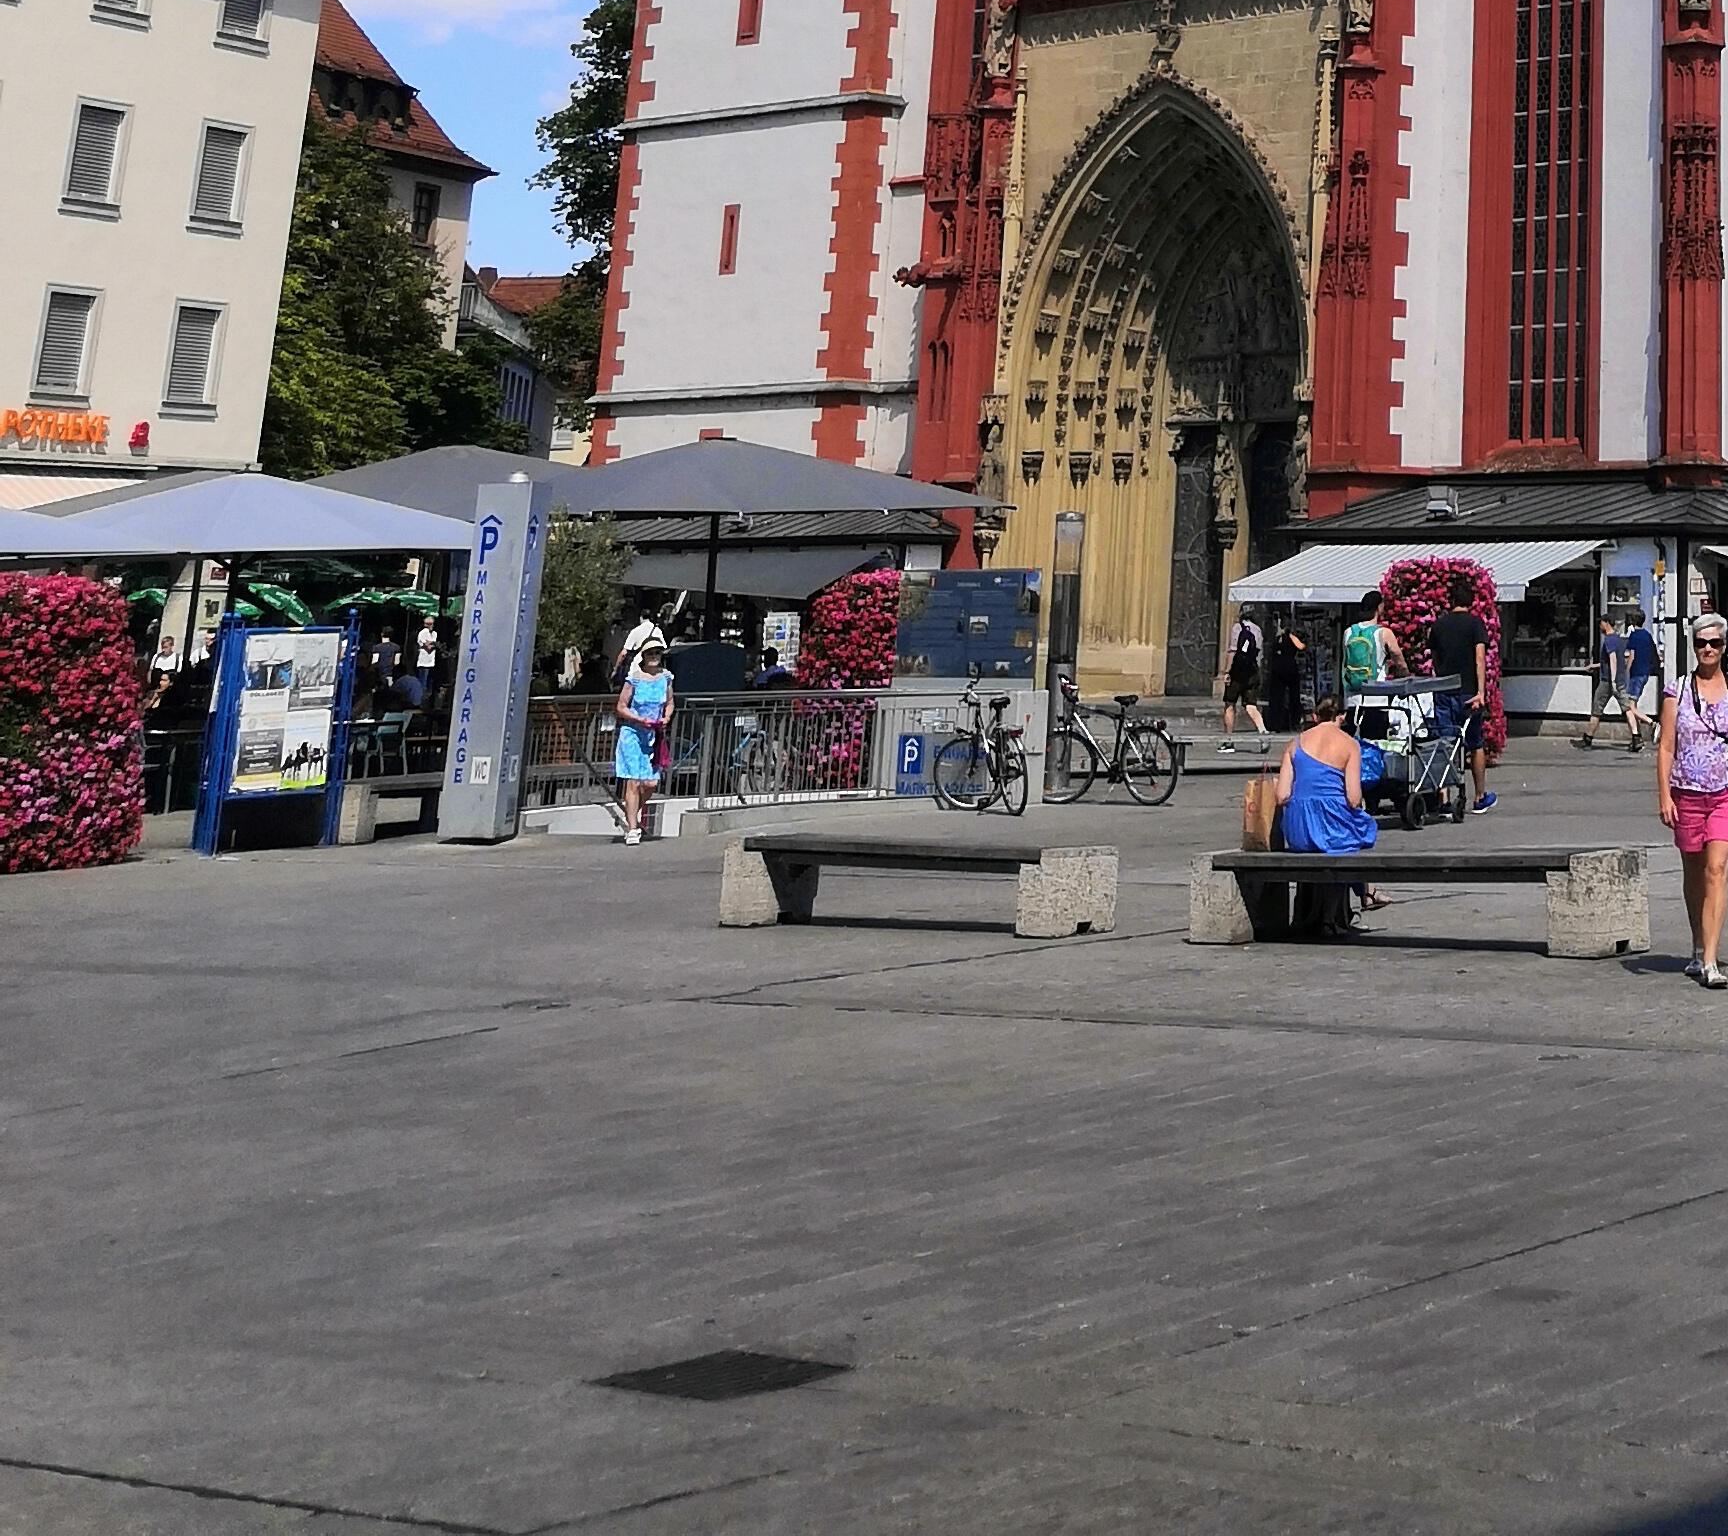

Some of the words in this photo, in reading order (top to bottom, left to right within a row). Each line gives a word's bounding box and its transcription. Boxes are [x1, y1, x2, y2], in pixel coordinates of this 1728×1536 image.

[453, 570, 488, 784] MARKTGARAGE
[474, 760, 488, 780] WC
[898, 782, 983, 795] MARKTARAGE
